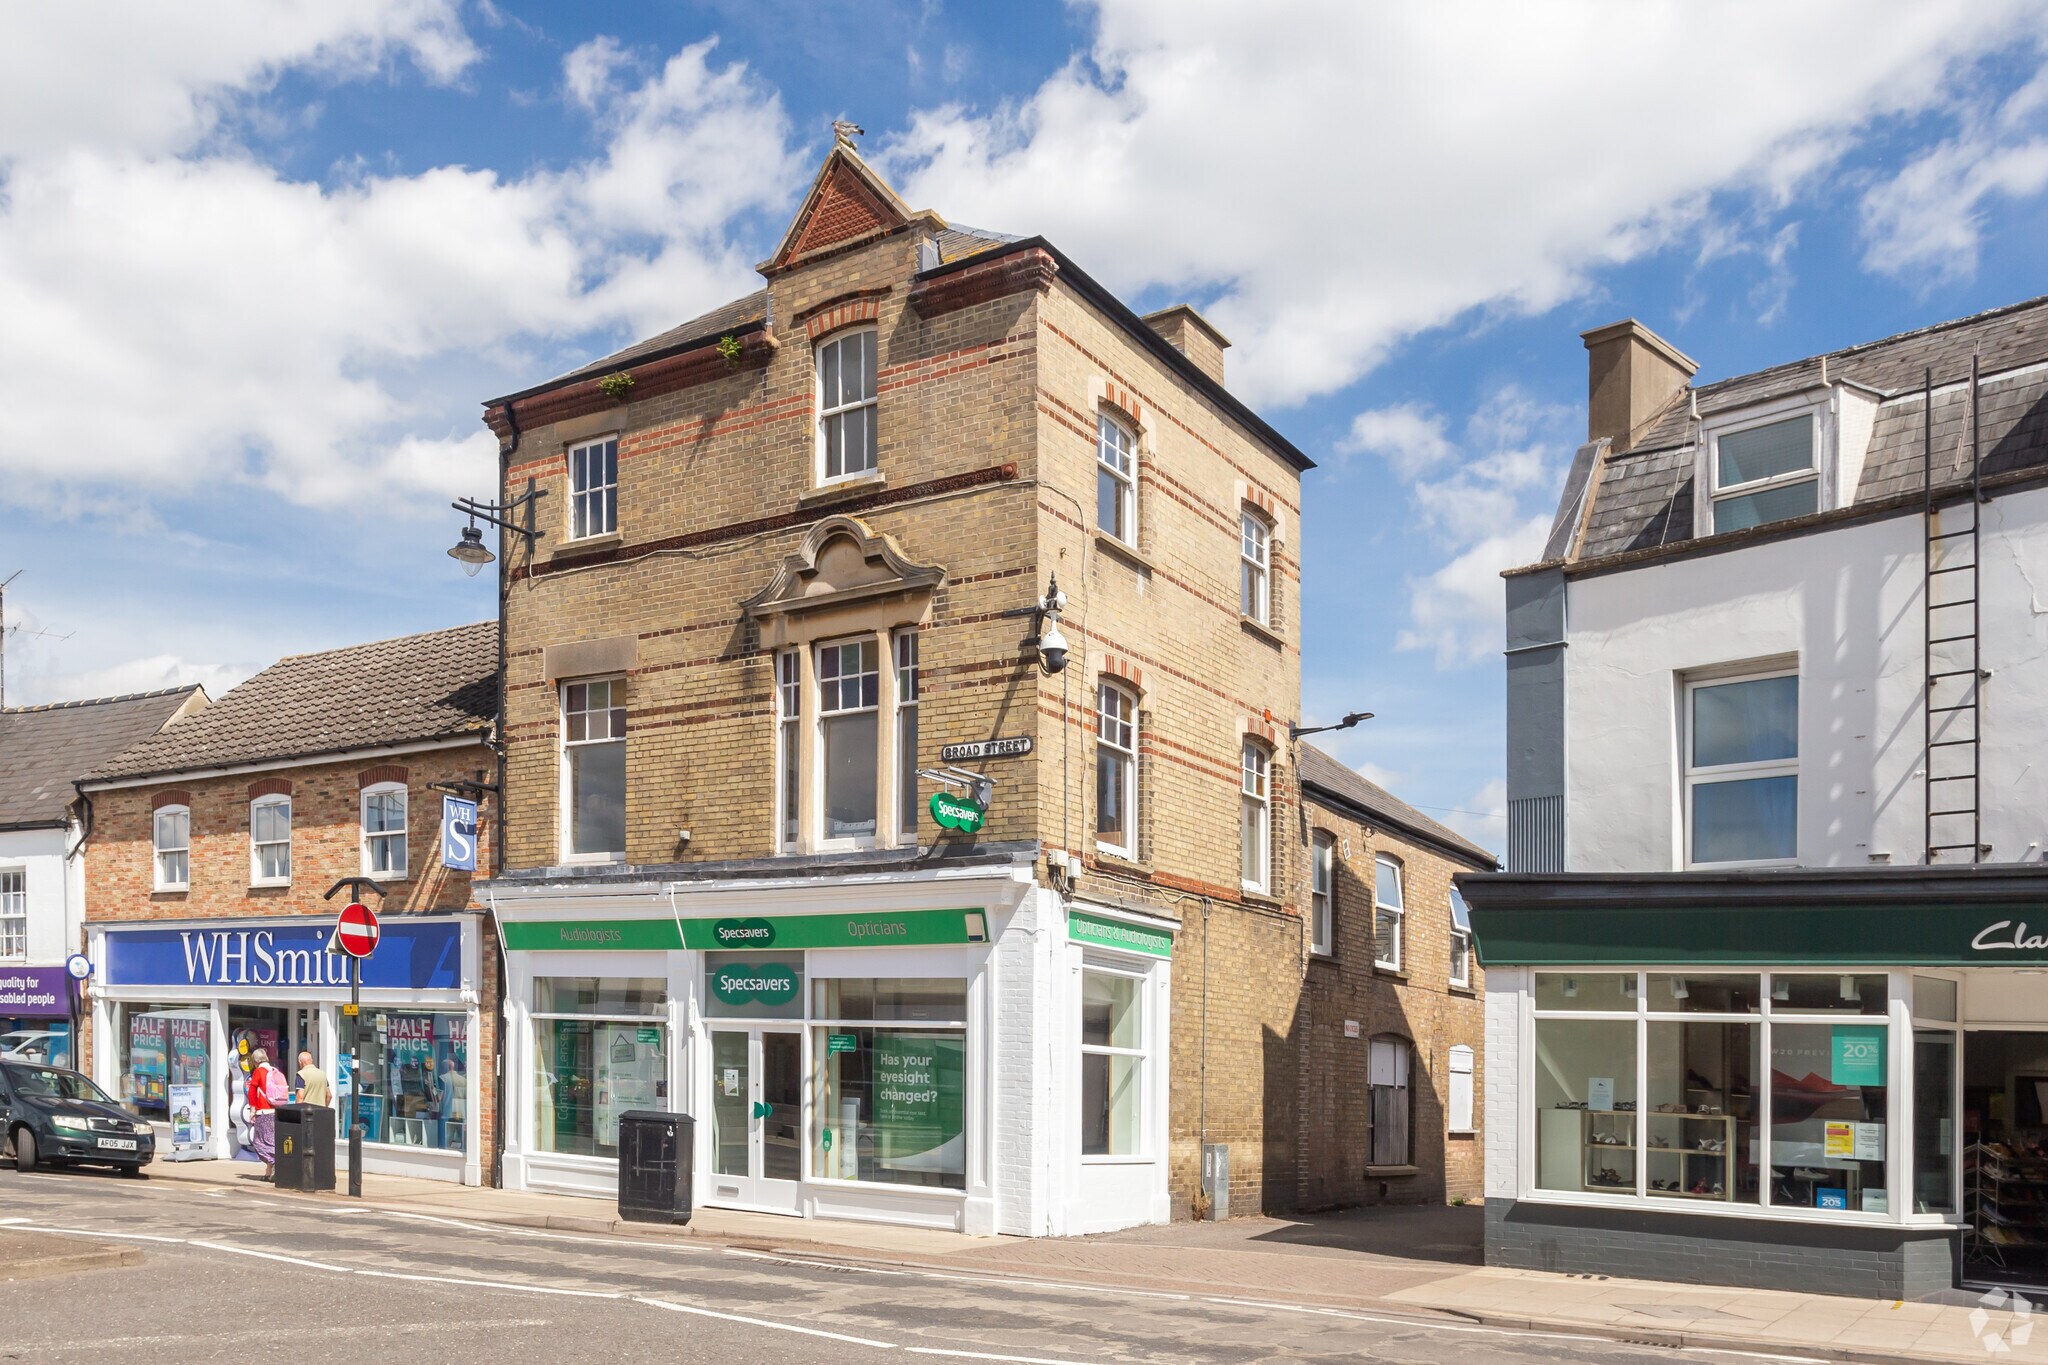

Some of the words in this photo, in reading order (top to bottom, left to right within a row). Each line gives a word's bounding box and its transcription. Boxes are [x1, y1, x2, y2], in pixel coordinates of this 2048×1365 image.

[944, 744, 981, 759] BROAD
[984, 739, 1028, 754] STREET
[449, 804, 471, 820] WH
[938, 800, 979, 823] Specsavers
[448, 818, 471, 862] S
[559, 927, 622, 944] Audiologists
[718, 926, 769, 940] Specsavers
[847, 920, 907, 939] Opticians
[1075, 917, 1112, 938] Opticians
[1121, 928, 1166, 949] Audiologists
[1971, 920, 2048, 950] Cla
[26, 976, 39, 988] for
[720, 975, 790, 994] Specsavers
[27, 993, 55, 1006] people
[131, 1017, 166, 1035] HALF
[171, 1019, 206, 1037] HALF
[387, 1018, 431, 1037] HALF
[448, 1020, 467, 1038] HA
[133, 1034, 162, 1047] PRICE
[174, 1036, 201, 1049] PRICE
[391, 1038, 429, 1051] PRICE
[558, 1028, 569, 1068] Lenses
[1843, 1043, 1878, 1058] 20%
[880, 1053, 899, 1066] Has
[902, 1055, 932, 1069] your
[880, 1069, 930, 1087] eyesight
[558, 1073, 569, 1120] Contact
[880, 1087, 938, 1105] changed?
[101, 1139, 119, 1147] AF05
[121, 1141, 135, 1149] JJX
